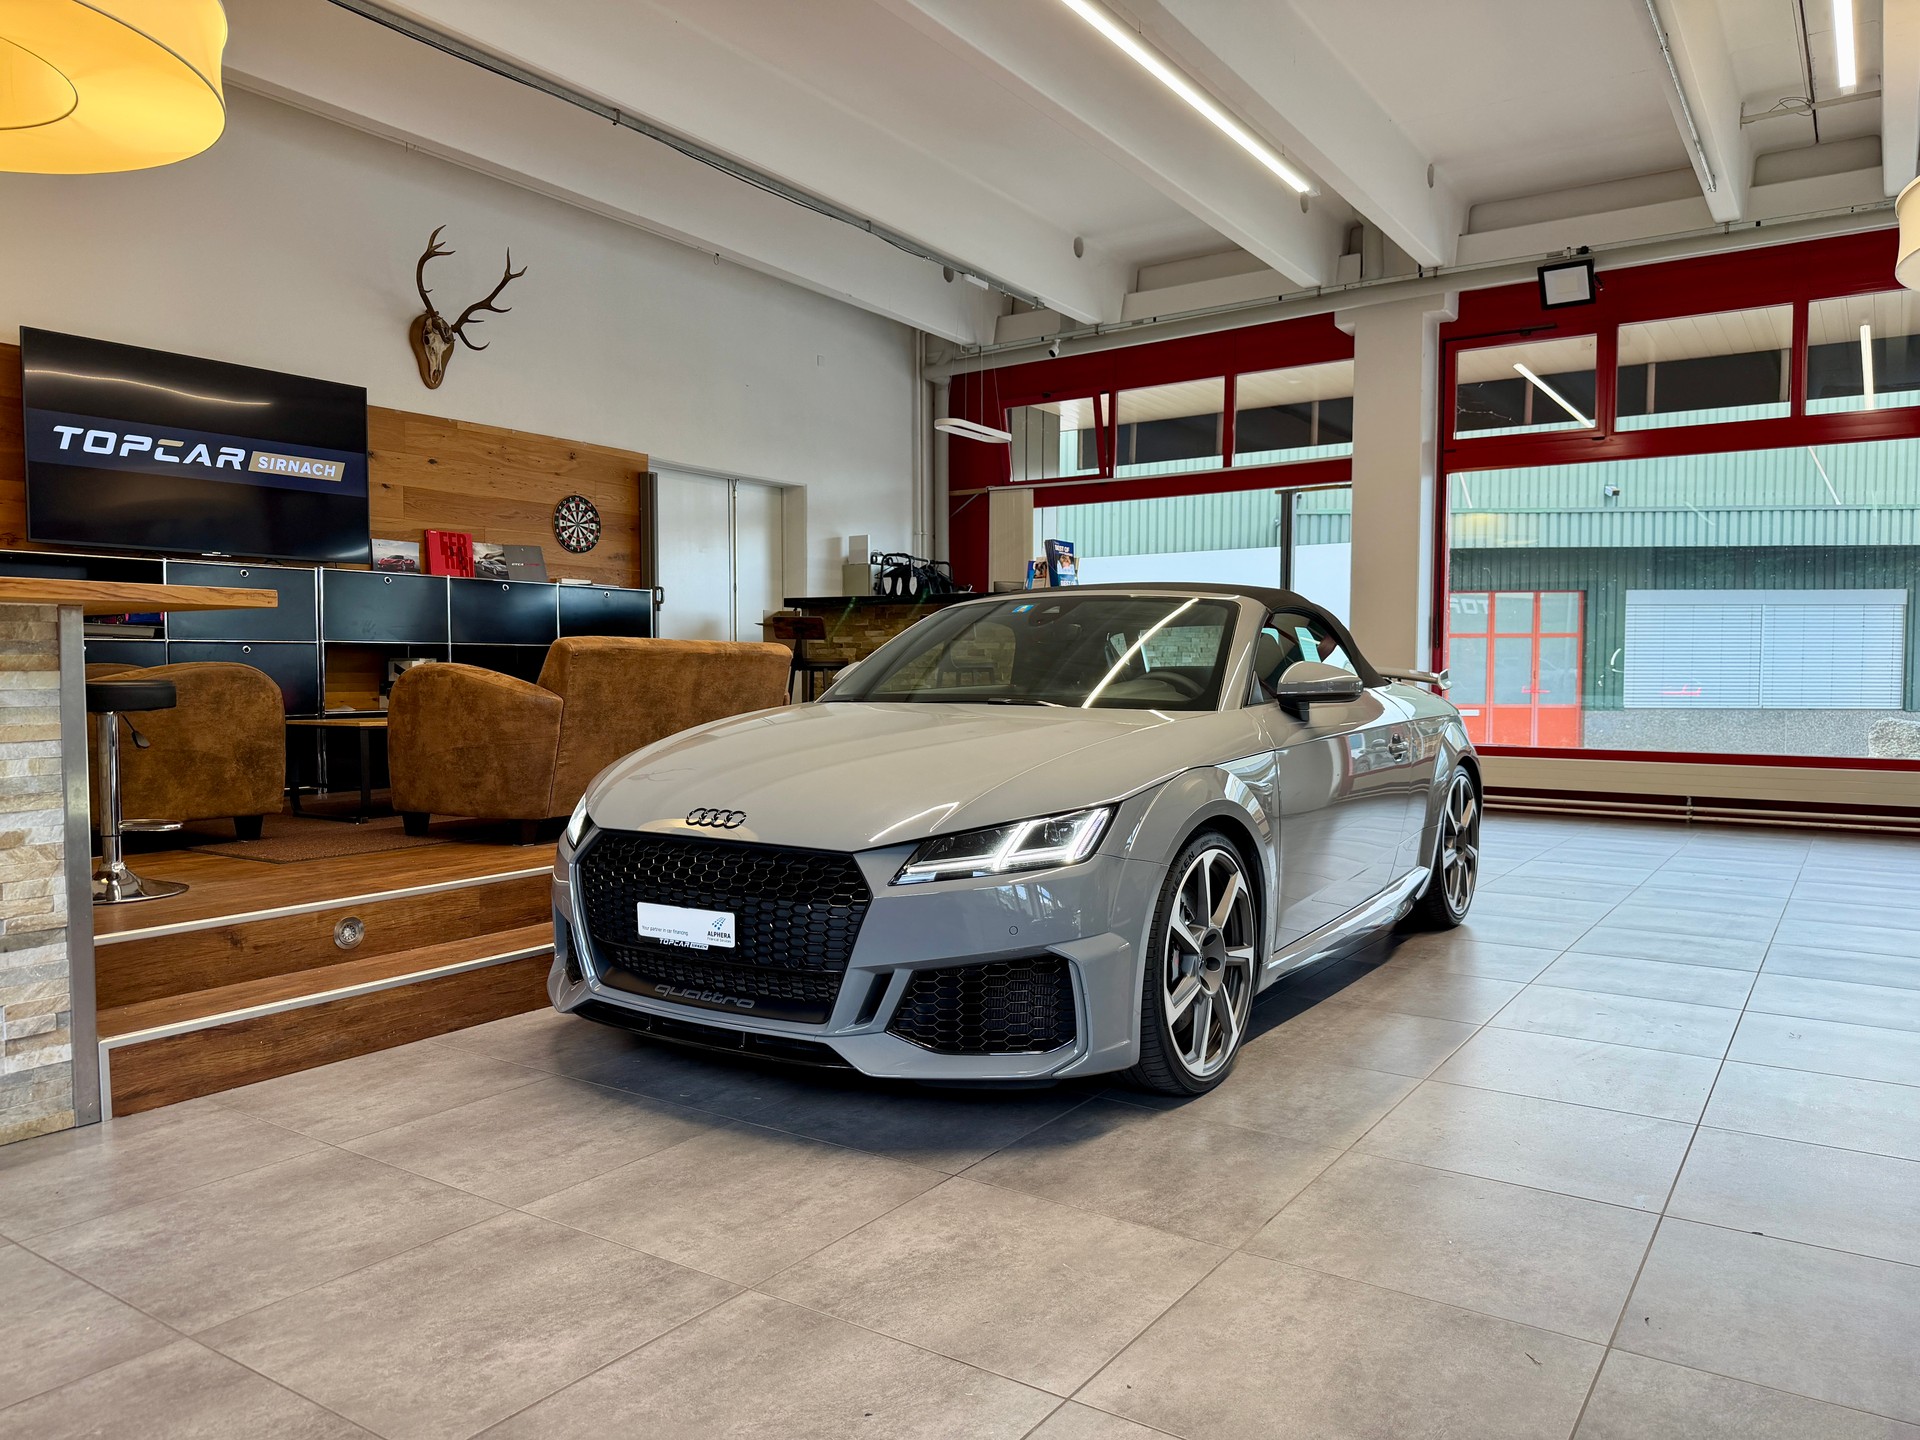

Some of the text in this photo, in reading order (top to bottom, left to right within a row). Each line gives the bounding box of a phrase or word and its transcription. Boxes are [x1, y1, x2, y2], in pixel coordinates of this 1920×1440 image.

[53, 425, 337, 477] TOPCAR SIRNACH
[1171, 851, 1196, 897] NEXEN
[659, 938, 691, 948] TOPCAR
[707, 930, 731, 939] ALPHERA
[654, 984, 755, 1009] quattro
